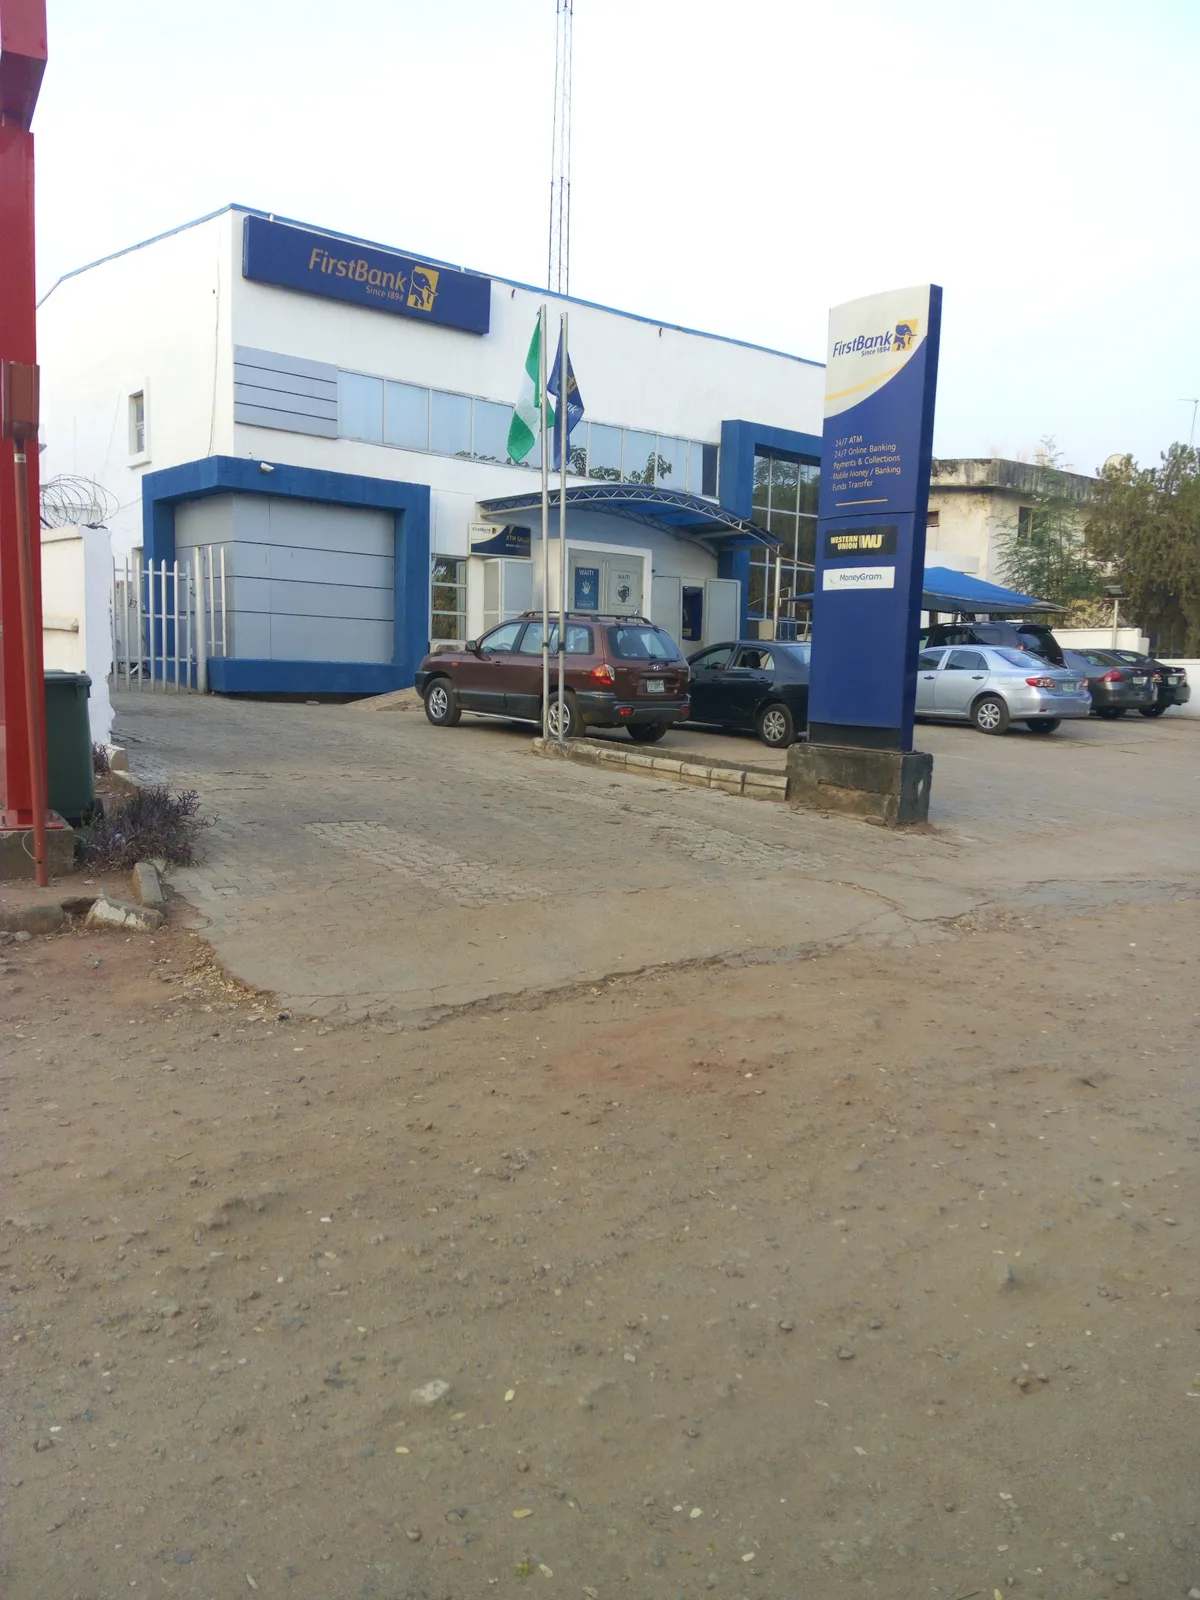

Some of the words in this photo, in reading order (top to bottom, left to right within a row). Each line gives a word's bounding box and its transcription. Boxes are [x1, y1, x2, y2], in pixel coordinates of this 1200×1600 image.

[309, 248, 407, 292] FirstBank
[366, 285, 386, 297] Since
[387, 290, 404, 302] 1894
[832, 331, 893, 358] FirstBank
[861, 348, 876, 357] Since
[877, 345, 891, 355] 1894
[835, 437, 848, 448] 24/7
[849, 435, 863, 444] ATM
[834, 448, 847, 459] 24/7
[848, 446, 867, 456] Online
[869, 443, 897, 453] Banking
[833, 460, 856, 470] Payments
[857, 457, 863, 466] &
[864, 454, 900, 465] Collections
[832, 471, 848, 481] Mobile
[849, 469, 869, 478] Money
[874, 465, 901, 475] Banking
[832, 482, 847, 492] Funds
[848, 478, 873, 489] Transfer
[830, 536, 858, 544] WESTERN
[837, 542, 858, 550] UNION
[840, 573, 882, 583] MoneyGram
